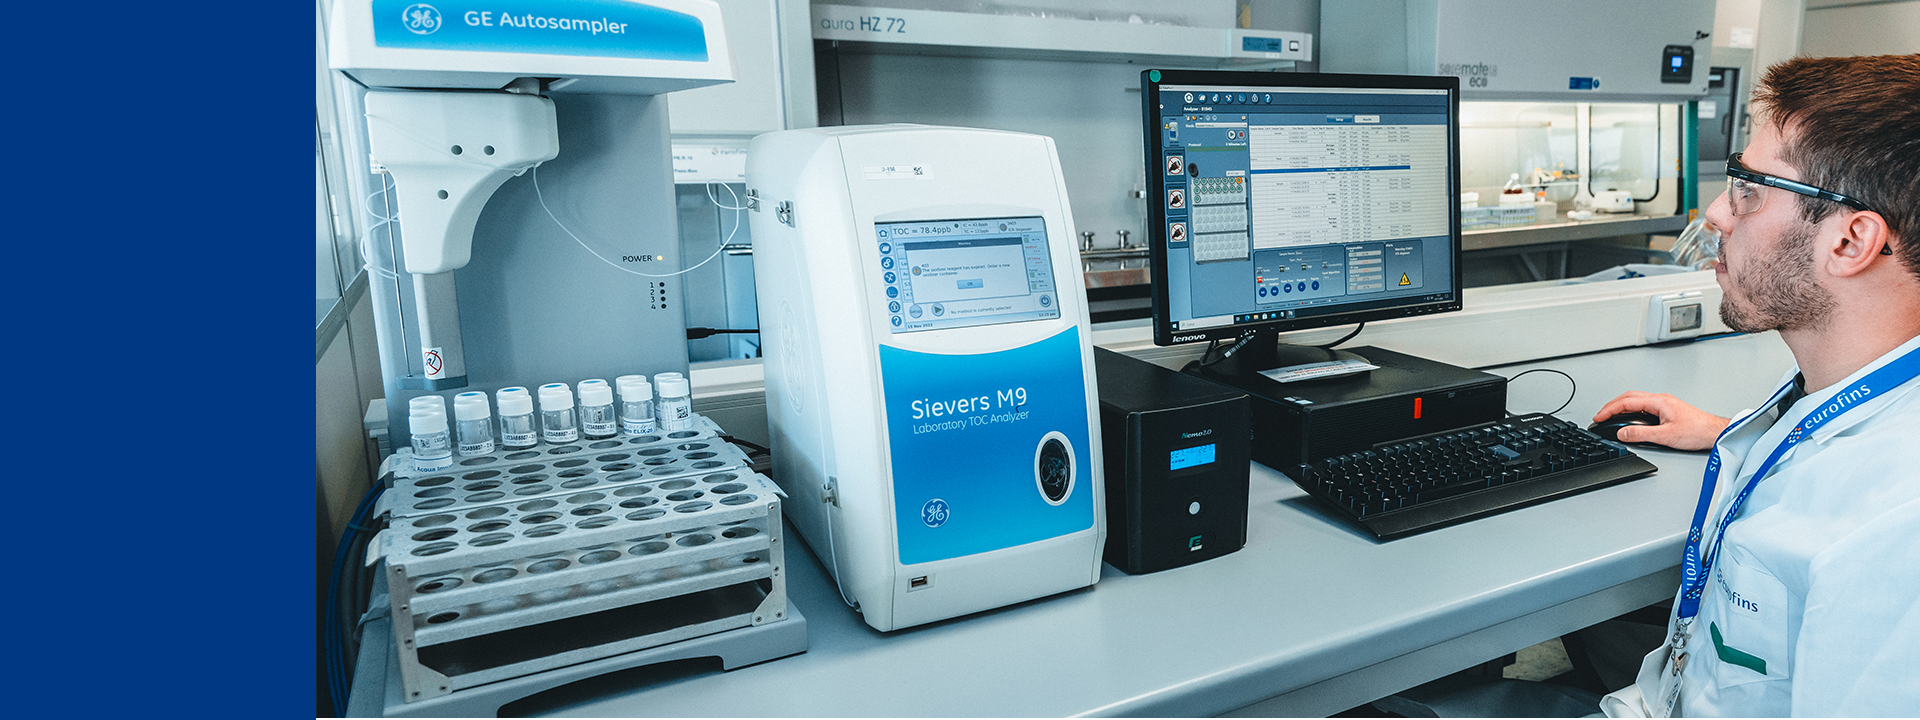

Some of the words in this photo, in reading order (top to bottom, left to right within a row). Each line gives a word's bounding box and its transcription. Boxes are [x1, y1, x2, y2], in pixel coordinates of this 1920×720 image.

[464, 11, 493, 26] GE
[500, 12, 628, 35] Autosampler
[821, 18, 854, 31] aura
[860, 16, 881, 32] HZ
[886, 17, 905, 33] 72
[1469, 76, 1488, 88] eco
[892, 227, 910, 236] TOC
[919, 226, 952, 235] 78.4ppb
[622, 254, 653, 263] POWER
[1172, 333, 1207, 343] lenovo
[911, 396, 990, 420] Sievers
[996, 387, 1027, 409] M9
[1804, 384, 1871, 429] eurofins
[913, 418, 968, 435] Laboratory
[968, 414, 989, 427] TOC
[990, 410, 1030, 424] Analyzer
